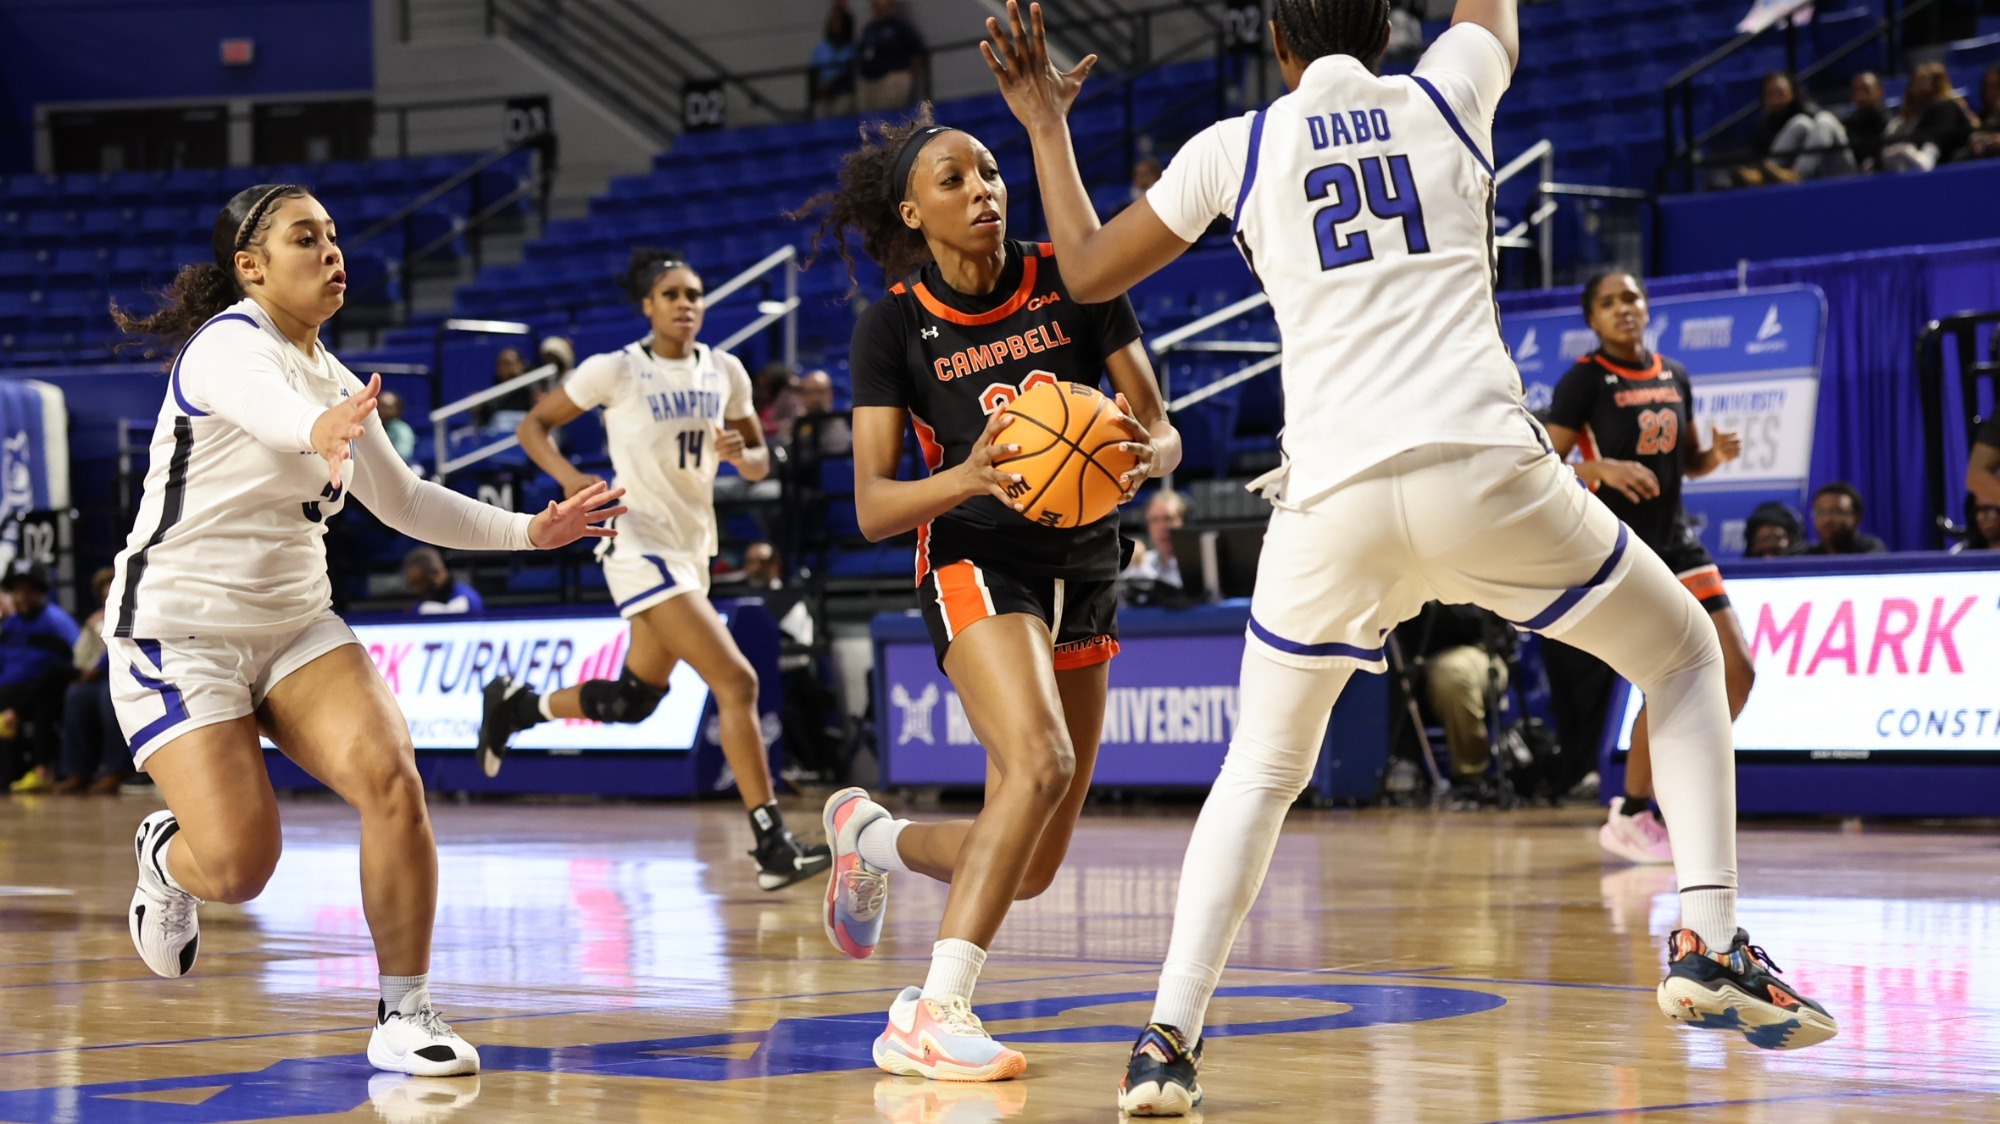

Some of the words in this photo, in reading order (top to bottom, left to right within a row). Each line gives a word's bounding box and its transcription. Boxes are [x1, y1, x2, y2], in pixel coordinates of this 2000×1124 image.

[1305, 108, 1391, 150] DABO
[1304, 153, 1431, 272] 24
[1028, 291, 1061, 311] CAA
[934, 320, 1071, 382] CAMPBELL
[677, 430, 704, 469] 14
[1636, 408, 1678, 455] 23
[23, 522, 55, 563] D2
[1751, 596, 1979, 676] MARK
[369, 643, 413, 694] RK
[418, 640, 573, 693] TURNER
[1100, 686, 1240, 744] NIVERSITY
[1876, 708, 2000, 738] CONST
